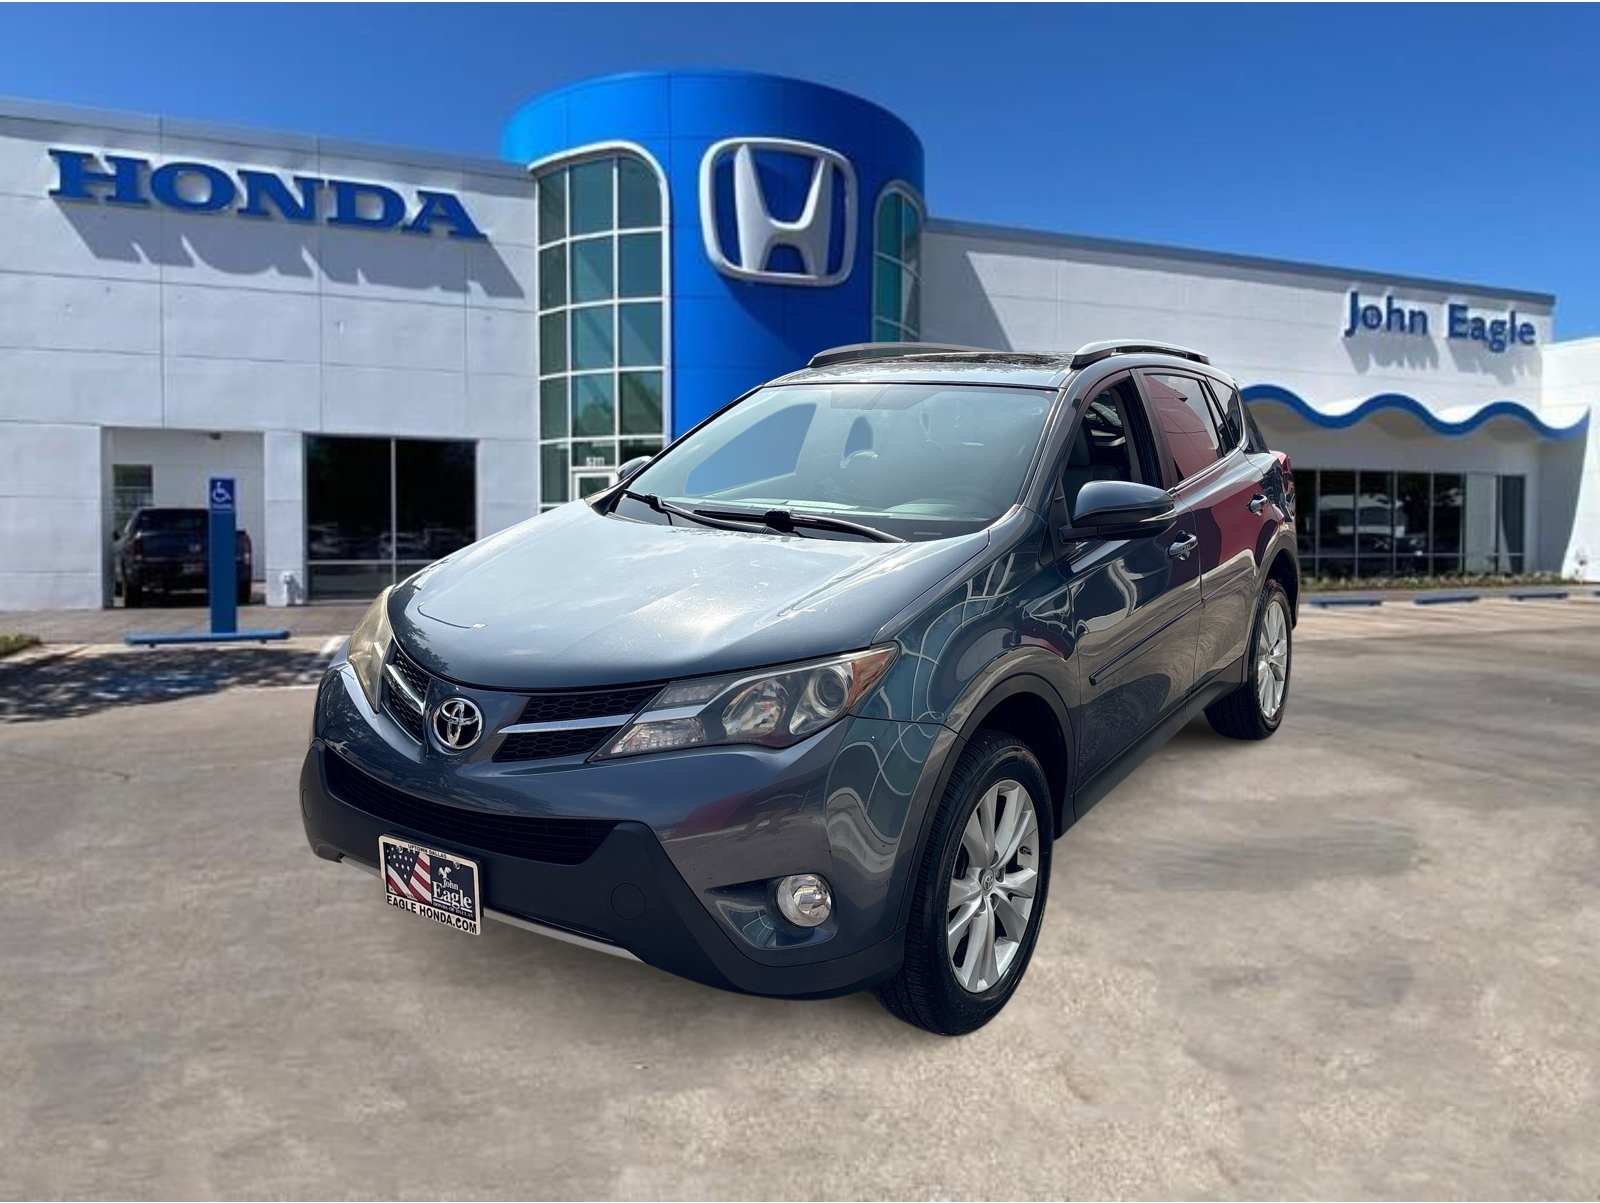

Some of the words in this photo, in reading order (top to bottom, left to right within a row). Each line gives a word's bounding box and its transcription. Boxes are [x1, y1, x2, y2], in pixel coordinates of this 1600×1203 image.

[48, 148, 488, 241] HONDA
[1344, 291, 1428, 338] John
[1448, 303, 1536, 353] Eagle
[428, 848, 447, 859] DALLAS
[432, 880, 473, 910] Eagle
[442, 879, 459, 891] John
[386, 895, 417, 914] EAGLE
[419, 904, 478, 935] HONDA.COM
